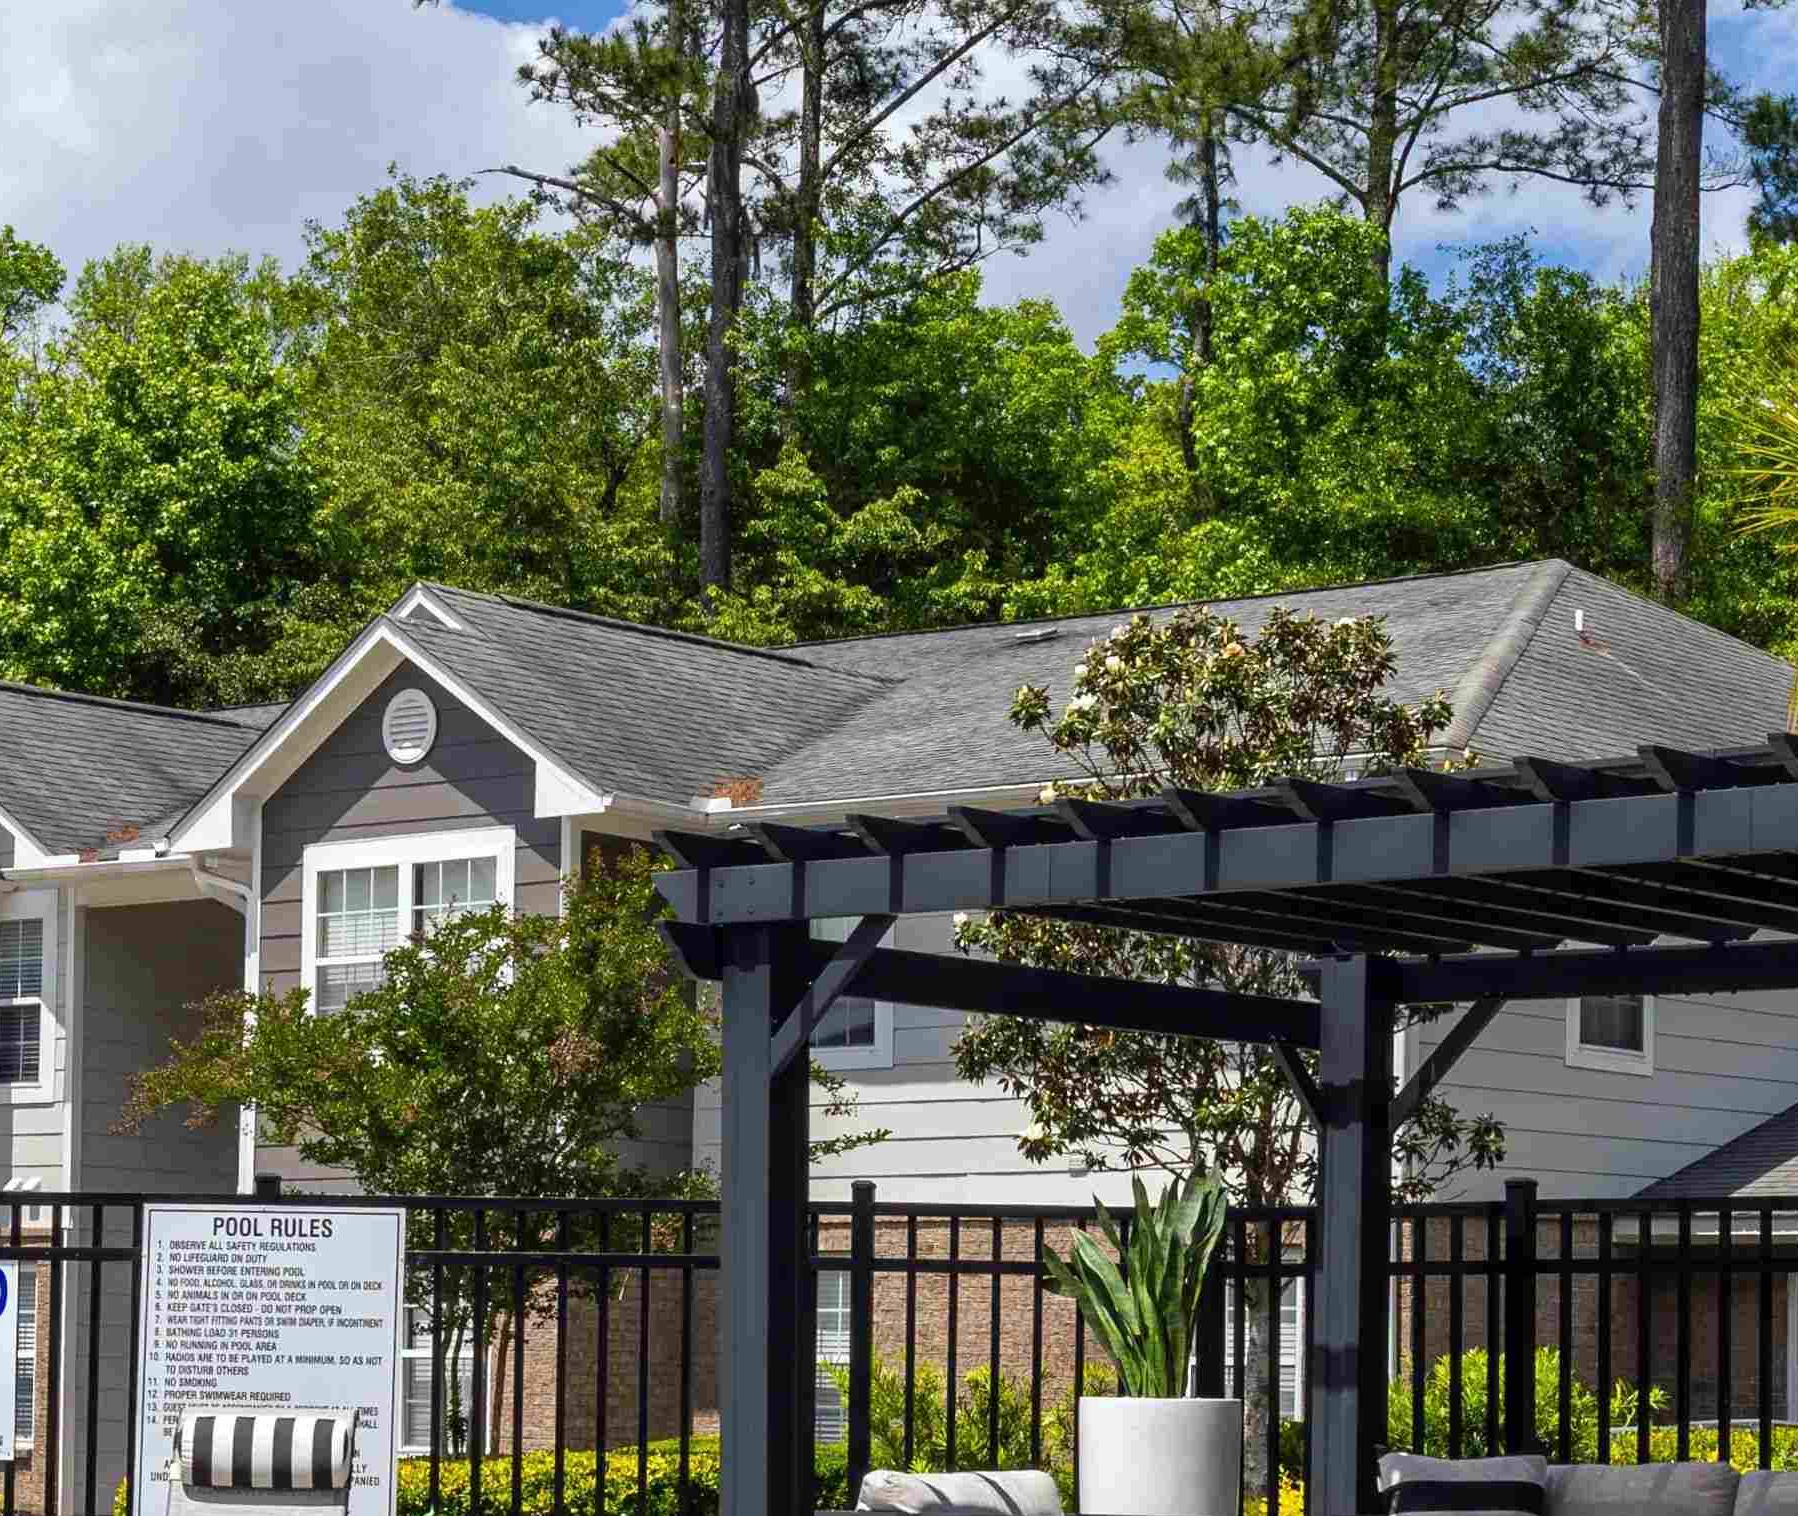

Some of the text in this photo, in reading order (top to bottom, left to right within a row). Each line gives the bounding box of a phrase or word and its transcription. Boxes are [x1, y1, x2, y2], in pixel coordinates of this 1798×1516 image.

[213, 1217, 333, 1238] POOL RULES
[169, 1240, 207, 1250] OBSERVE
[209, 1241, 224, 1250] ALL
[226, 1241, 257, 1251] SAFETY
[259, 1242, 316, 1252] REGULATIONS
[169, 1253, 181, 1263] NO
[183, 1253, 229, 1263] LIFEGUARD
[232, 1254, 243, 1264] ON
[245, 1254, 267, 1264] DUTY
[169, 1265, 204, 1275] SHOWER
[206, 1265, 238, 1276] BEFORE
[240, 1266, 281, 1277] ENTERING
[282, 1266, 305, 1277] POOL
[168, 1278, 179, 1288] NO
[267, 1279, 278, 1289] OR
[308, 1280, 316, 1290] IN
[317, 1280, 337, 1290] POOL
[339, 1280, 349, 1290] OR
[351, 1281, 361, 1291] ON
[363, 1281, 382, 1291] DECK
[168, 1290, 180, 1300] NO
[181, 1290, 218, 1300] ANIMALS
[221, 1291, 229, 1300] IN
[232, 1291, 243, 1301] OR
[246, 1291, 258, 1301] ON
[260, 1291, 281, 1301] POOL
[284, 1292, 307, 1302] DECK
[167, 1302, 188, 1312] KEEP
[221, 1303, 253, 1313] CLOSED
[261, 1304, 273, 1313] DO
[275, 1304, 292, 1314] NOT
[295, 1304, 317, 1314] PROP
[319, 1305, 342, 1315] OPEN
[167, 1315, 188, 1325] WEAR
[211, 1315, 238, 1326] FITTING
[240, 1316, 263, 1326] PANTS
[265, 1316, 275, 1326] OR
[165, 1327, 202, 1338] BATHING
[204, 1328, 226, 1338] LOAD
[241, 1328, 280, 1339] PERSONS
[165, 1339, 178, 1350] NO
[180, 1340, 218, 1350] RUNNING
[220, 1341, 229, 1351] IN
[231, 1341, 253, 1351] POOL
[256, 1341, 277, 1352] AREA
[165, 1352, 196, 1362] RADIOS
[198, 1352, 213, 1363] ARE
[216, 1353, 227, 1363] TO
[229, 1353, 239, 1363] BE
[241, 1353, 272, 1364] PLAYED
[274, 1354, 286, 1364] AT
[287, 1354, 293, 1364] A
[339, 1355, 351, 1365] SO
[353, 1356, 364, 1365] AS
[366, 1356, 383, 1366] NOT
[166, 1365, 250, 1376] TO DISTURB OTHERS
[164, 1377, 177, 1387] NO
[179, 1377, 218, 1388] SMOKING
[164, 1390, 197, 1401] PROPER
[199, 1391, 247, 1401] SWIMWEAR
[249, 1391, 291, 1402] REQUIRED
